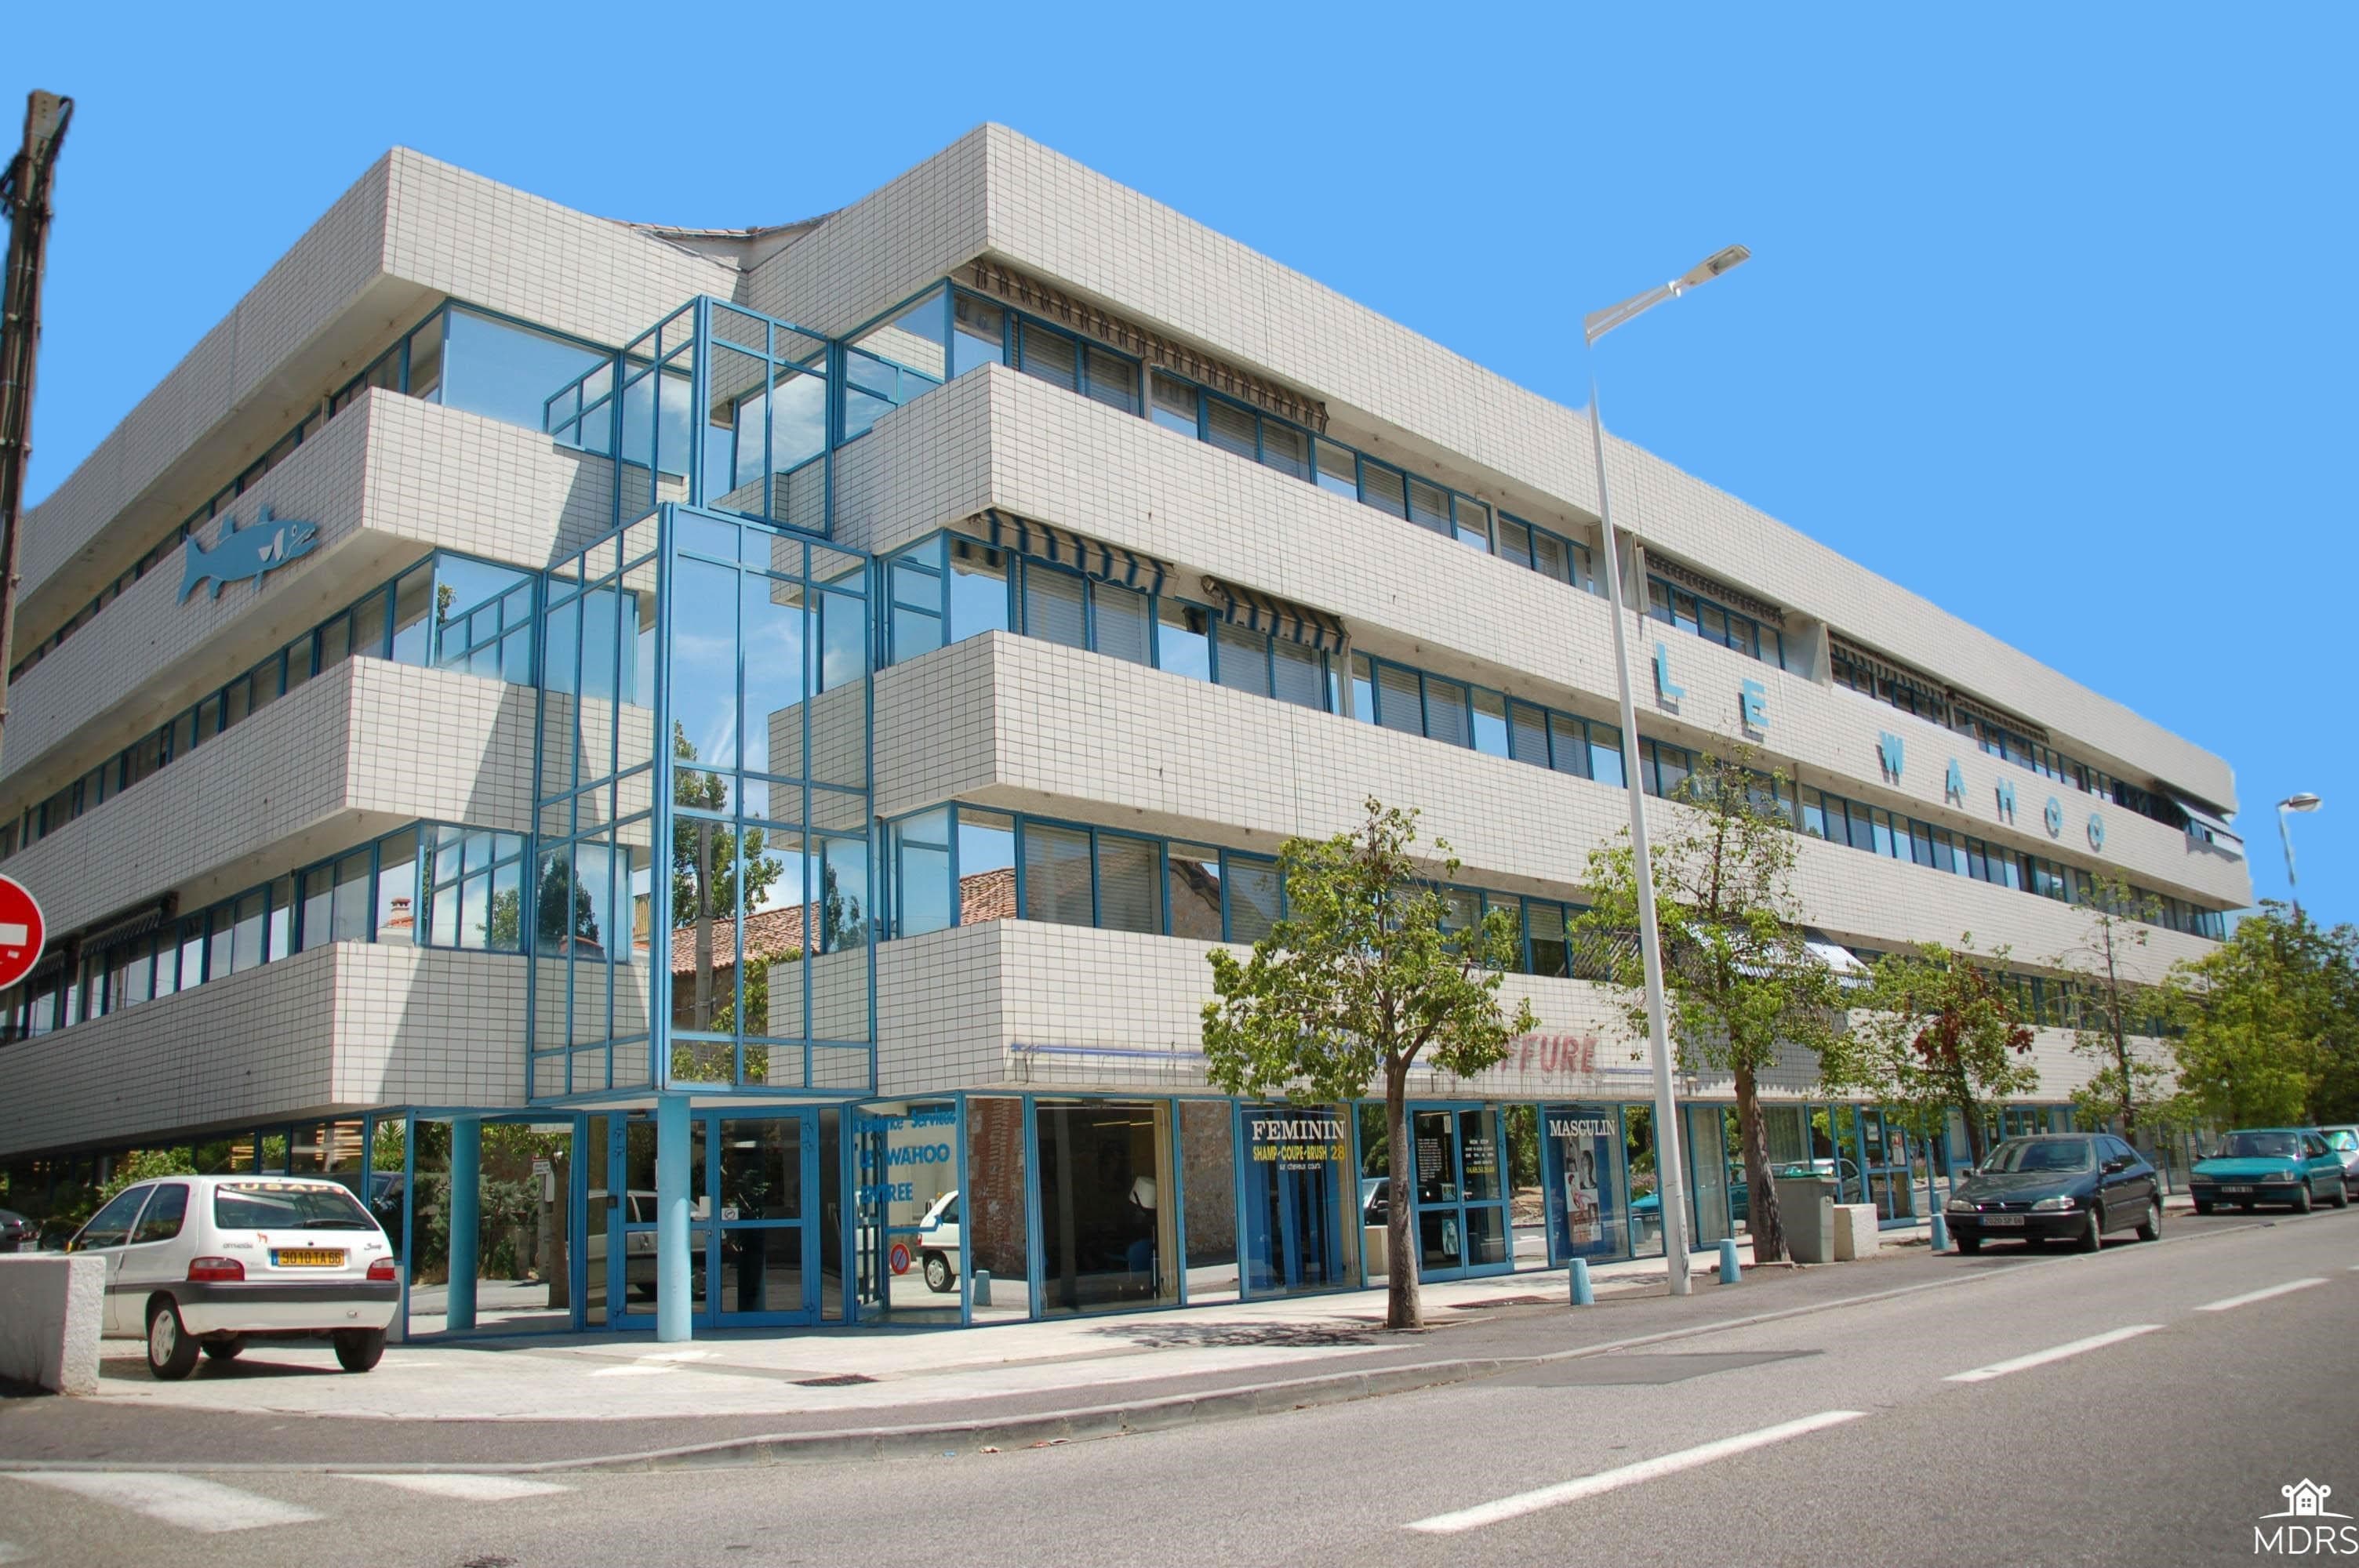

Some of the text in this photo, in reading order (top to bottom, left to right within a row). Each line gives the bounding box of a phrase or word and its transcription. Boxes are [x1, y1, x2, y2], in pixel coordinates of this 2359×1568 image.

[1656, 642, 2106, 838] LE WAHOO
[1550, 1119, 1616, 1137] MASCULIN
[886, 1142, 951, 1166] WAHOO
[1331, 1145, 1346, 1160] 28
[282, 1249, 342, 1264] 9010 TA 66
